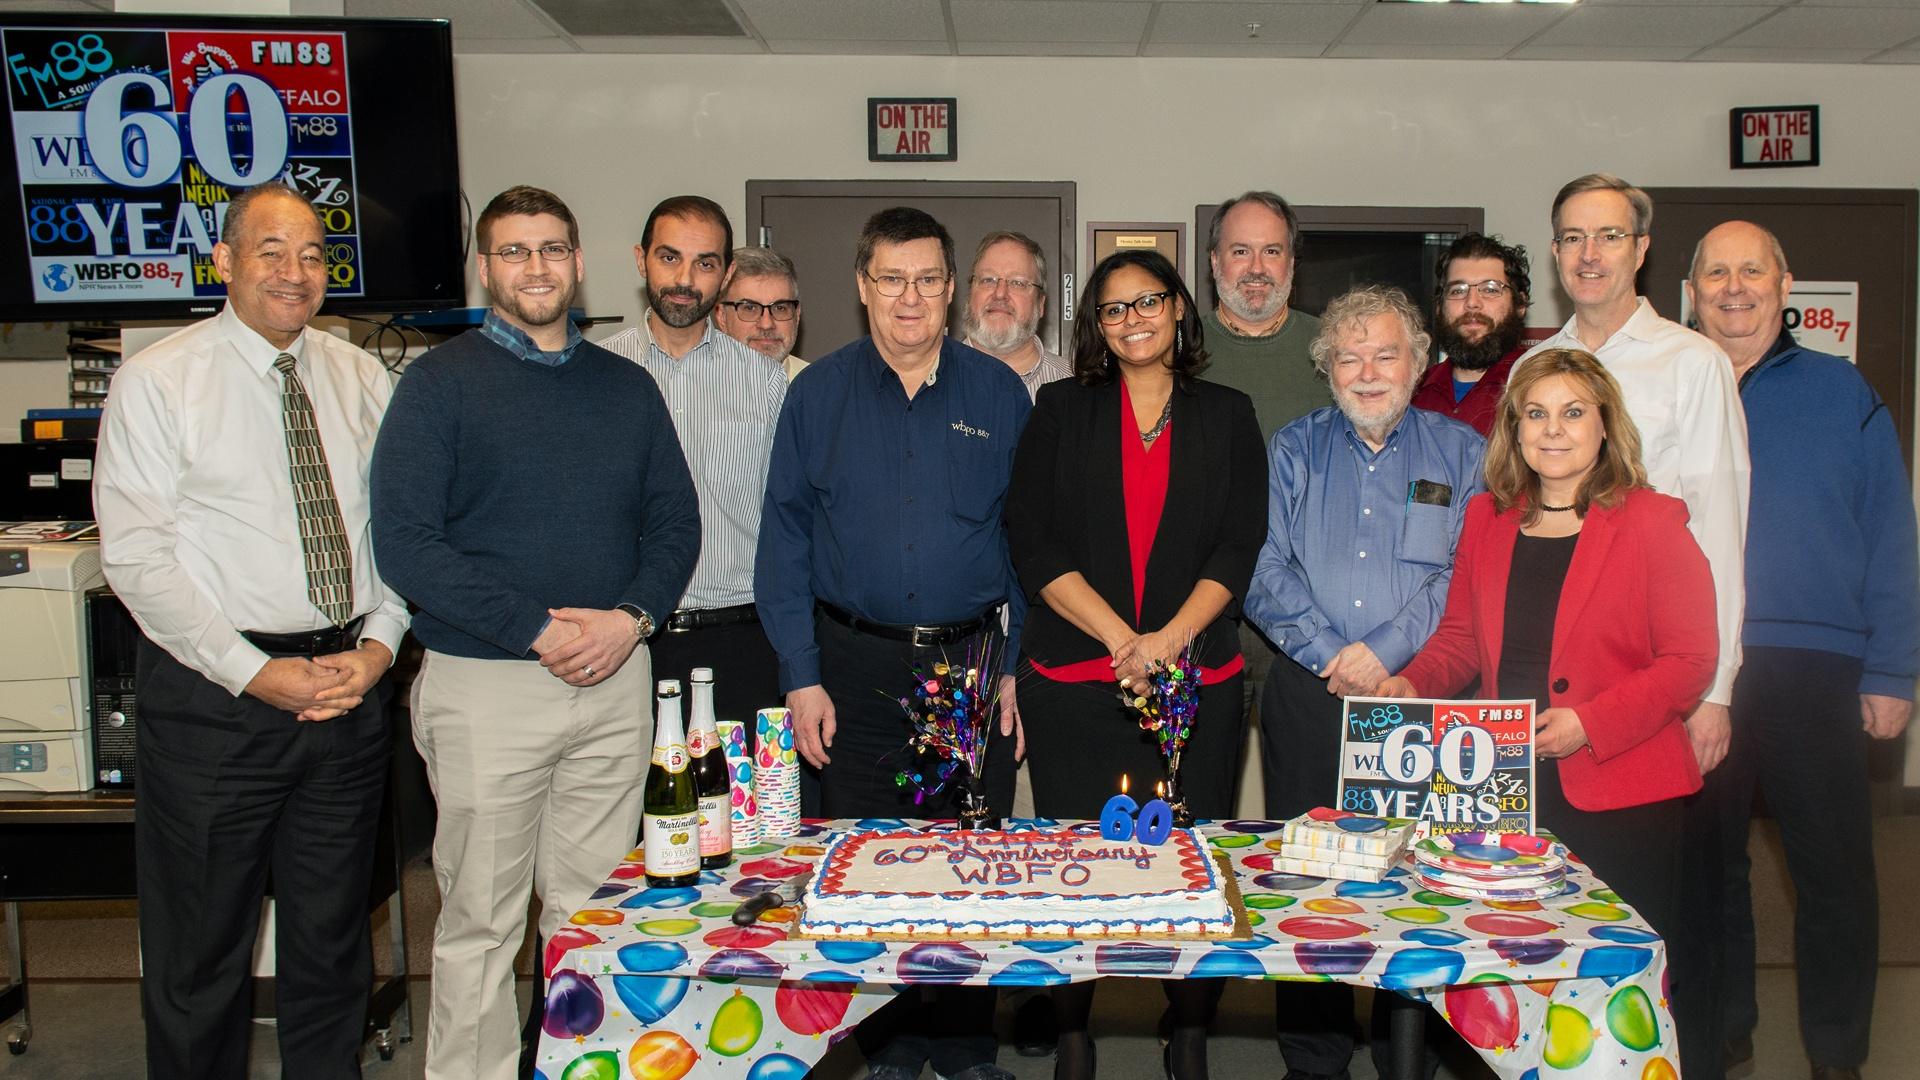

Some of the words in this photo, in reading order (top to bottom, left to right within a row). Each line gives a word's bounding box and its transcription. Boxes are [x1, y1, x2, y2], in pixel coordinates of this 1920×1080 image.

[197, 42, 239, 69] Support
[251, 41, 332, 65] FM88
[8, 34, 113, 101] FM88
[277, 89, 341, 107] FFALO
[85, 73, 288, 187] 60
[290, 117, 338, 143] FM88
[879, 105, 906, 129] ON
[911, 105, 947, 129] THE
[1743, 115, 1770, 138] ON
[1773, 112, 1809, 136] THE
[896, 130, 931, 153] AIR
[1760, 138, 1793, 161] AIR
[279, 162, 350, 206] AZZ
[76, 202, 229, 257] YEA
[74, 262, 142, 281] WBFO
[143, 261, 184, 288] 88.7
[1803, 307, 1851, 343] 88.7
[1349, 704, 1404, 740] FM88
[1479, 708, 1524, 722] FM88
[1383, 724, 1495, 785] 60
[1371, 790, 1501, 824] YEARS
[1497, 796, 1528, 811] BFO
[1100, 794, 1174, 846] 60
[947, 838, 1158, 870] Anniversary
[951, 861, 1091, 887] WBFO
